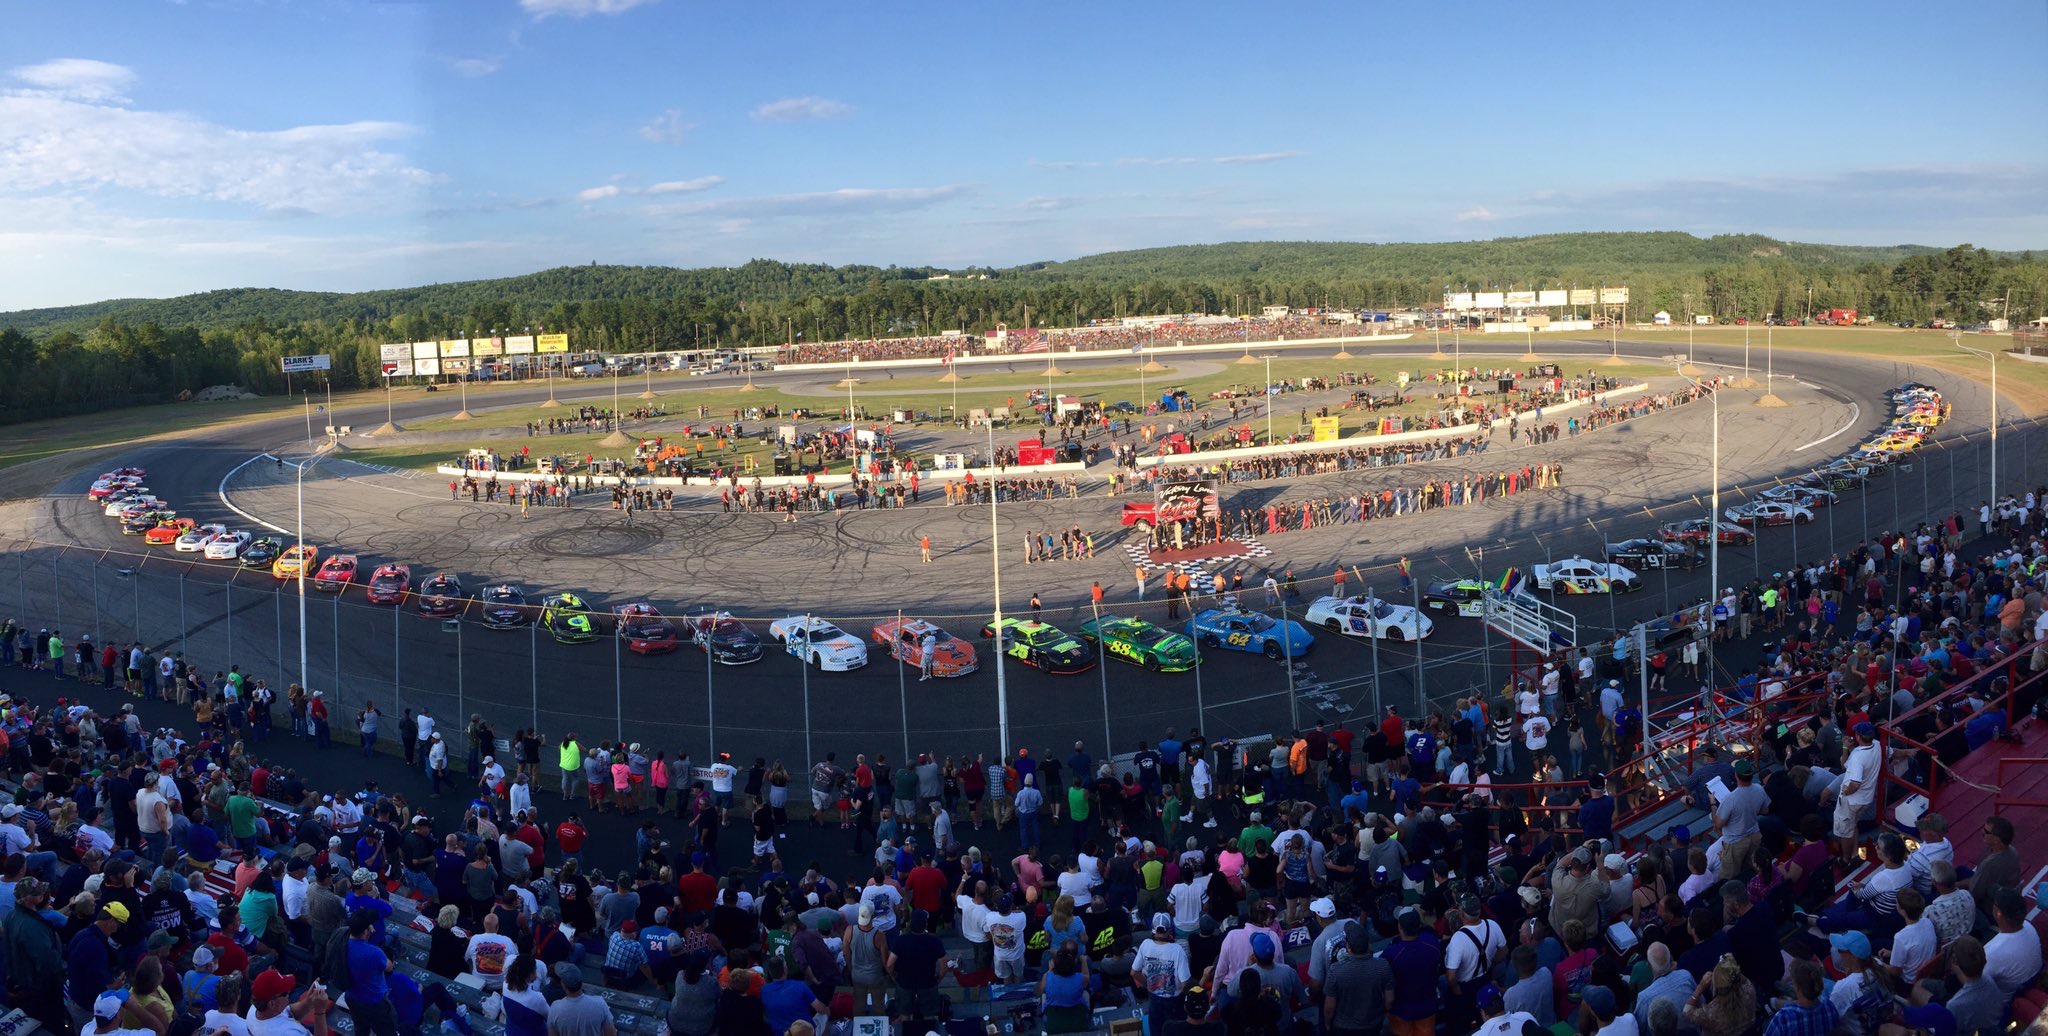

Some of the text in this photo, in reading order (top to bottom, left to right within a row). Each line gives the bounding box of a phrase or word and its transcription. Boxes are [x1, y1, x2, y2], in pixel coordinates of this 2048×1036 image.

[284, 356, 313, 365] CLARK'S
[1159, 498, 1200, 517] Oxford
[1577, 579, 1598, 589] 54
[1227, 632, 1251, 646] 64
[1110, 641, 1131, 655] 88
[1416, 738, 1426, 746] 2
[1094, 925, 1114, 945] 42
[650, 941, 663, 951] 24
